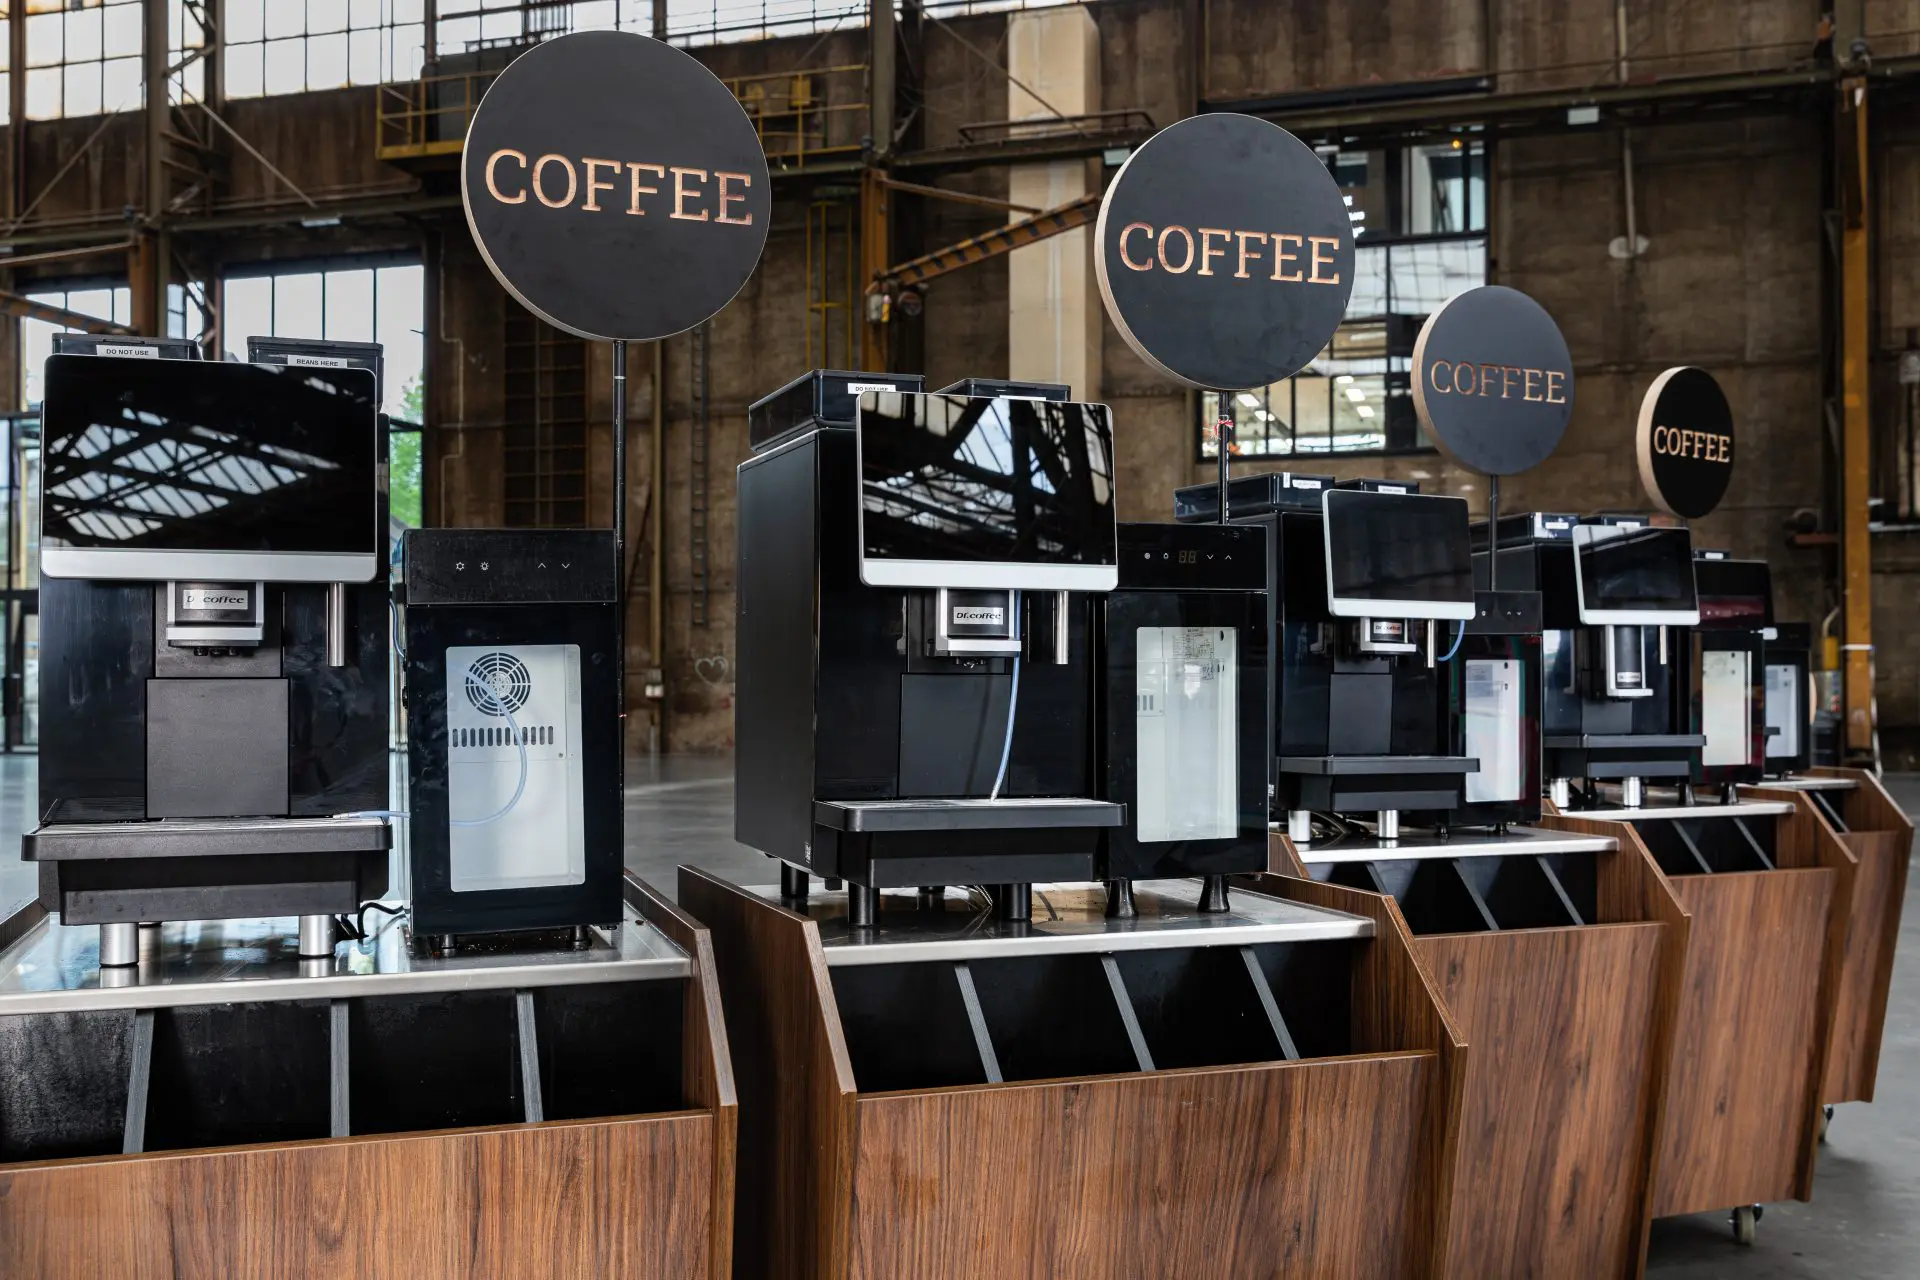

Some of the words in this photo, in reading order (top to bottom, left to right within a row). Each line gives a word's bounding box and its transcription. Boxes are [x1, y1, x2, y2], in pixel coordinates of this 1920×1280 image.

[486, 149, 752, 226] COFFEE
[1120, 222, 1340, 285] COFFEE
[118, 348, 132, 356] NOT
[1431, 359, 1566, 404] COFFEE
[1654, 425, 1731, 463] COFFEE
